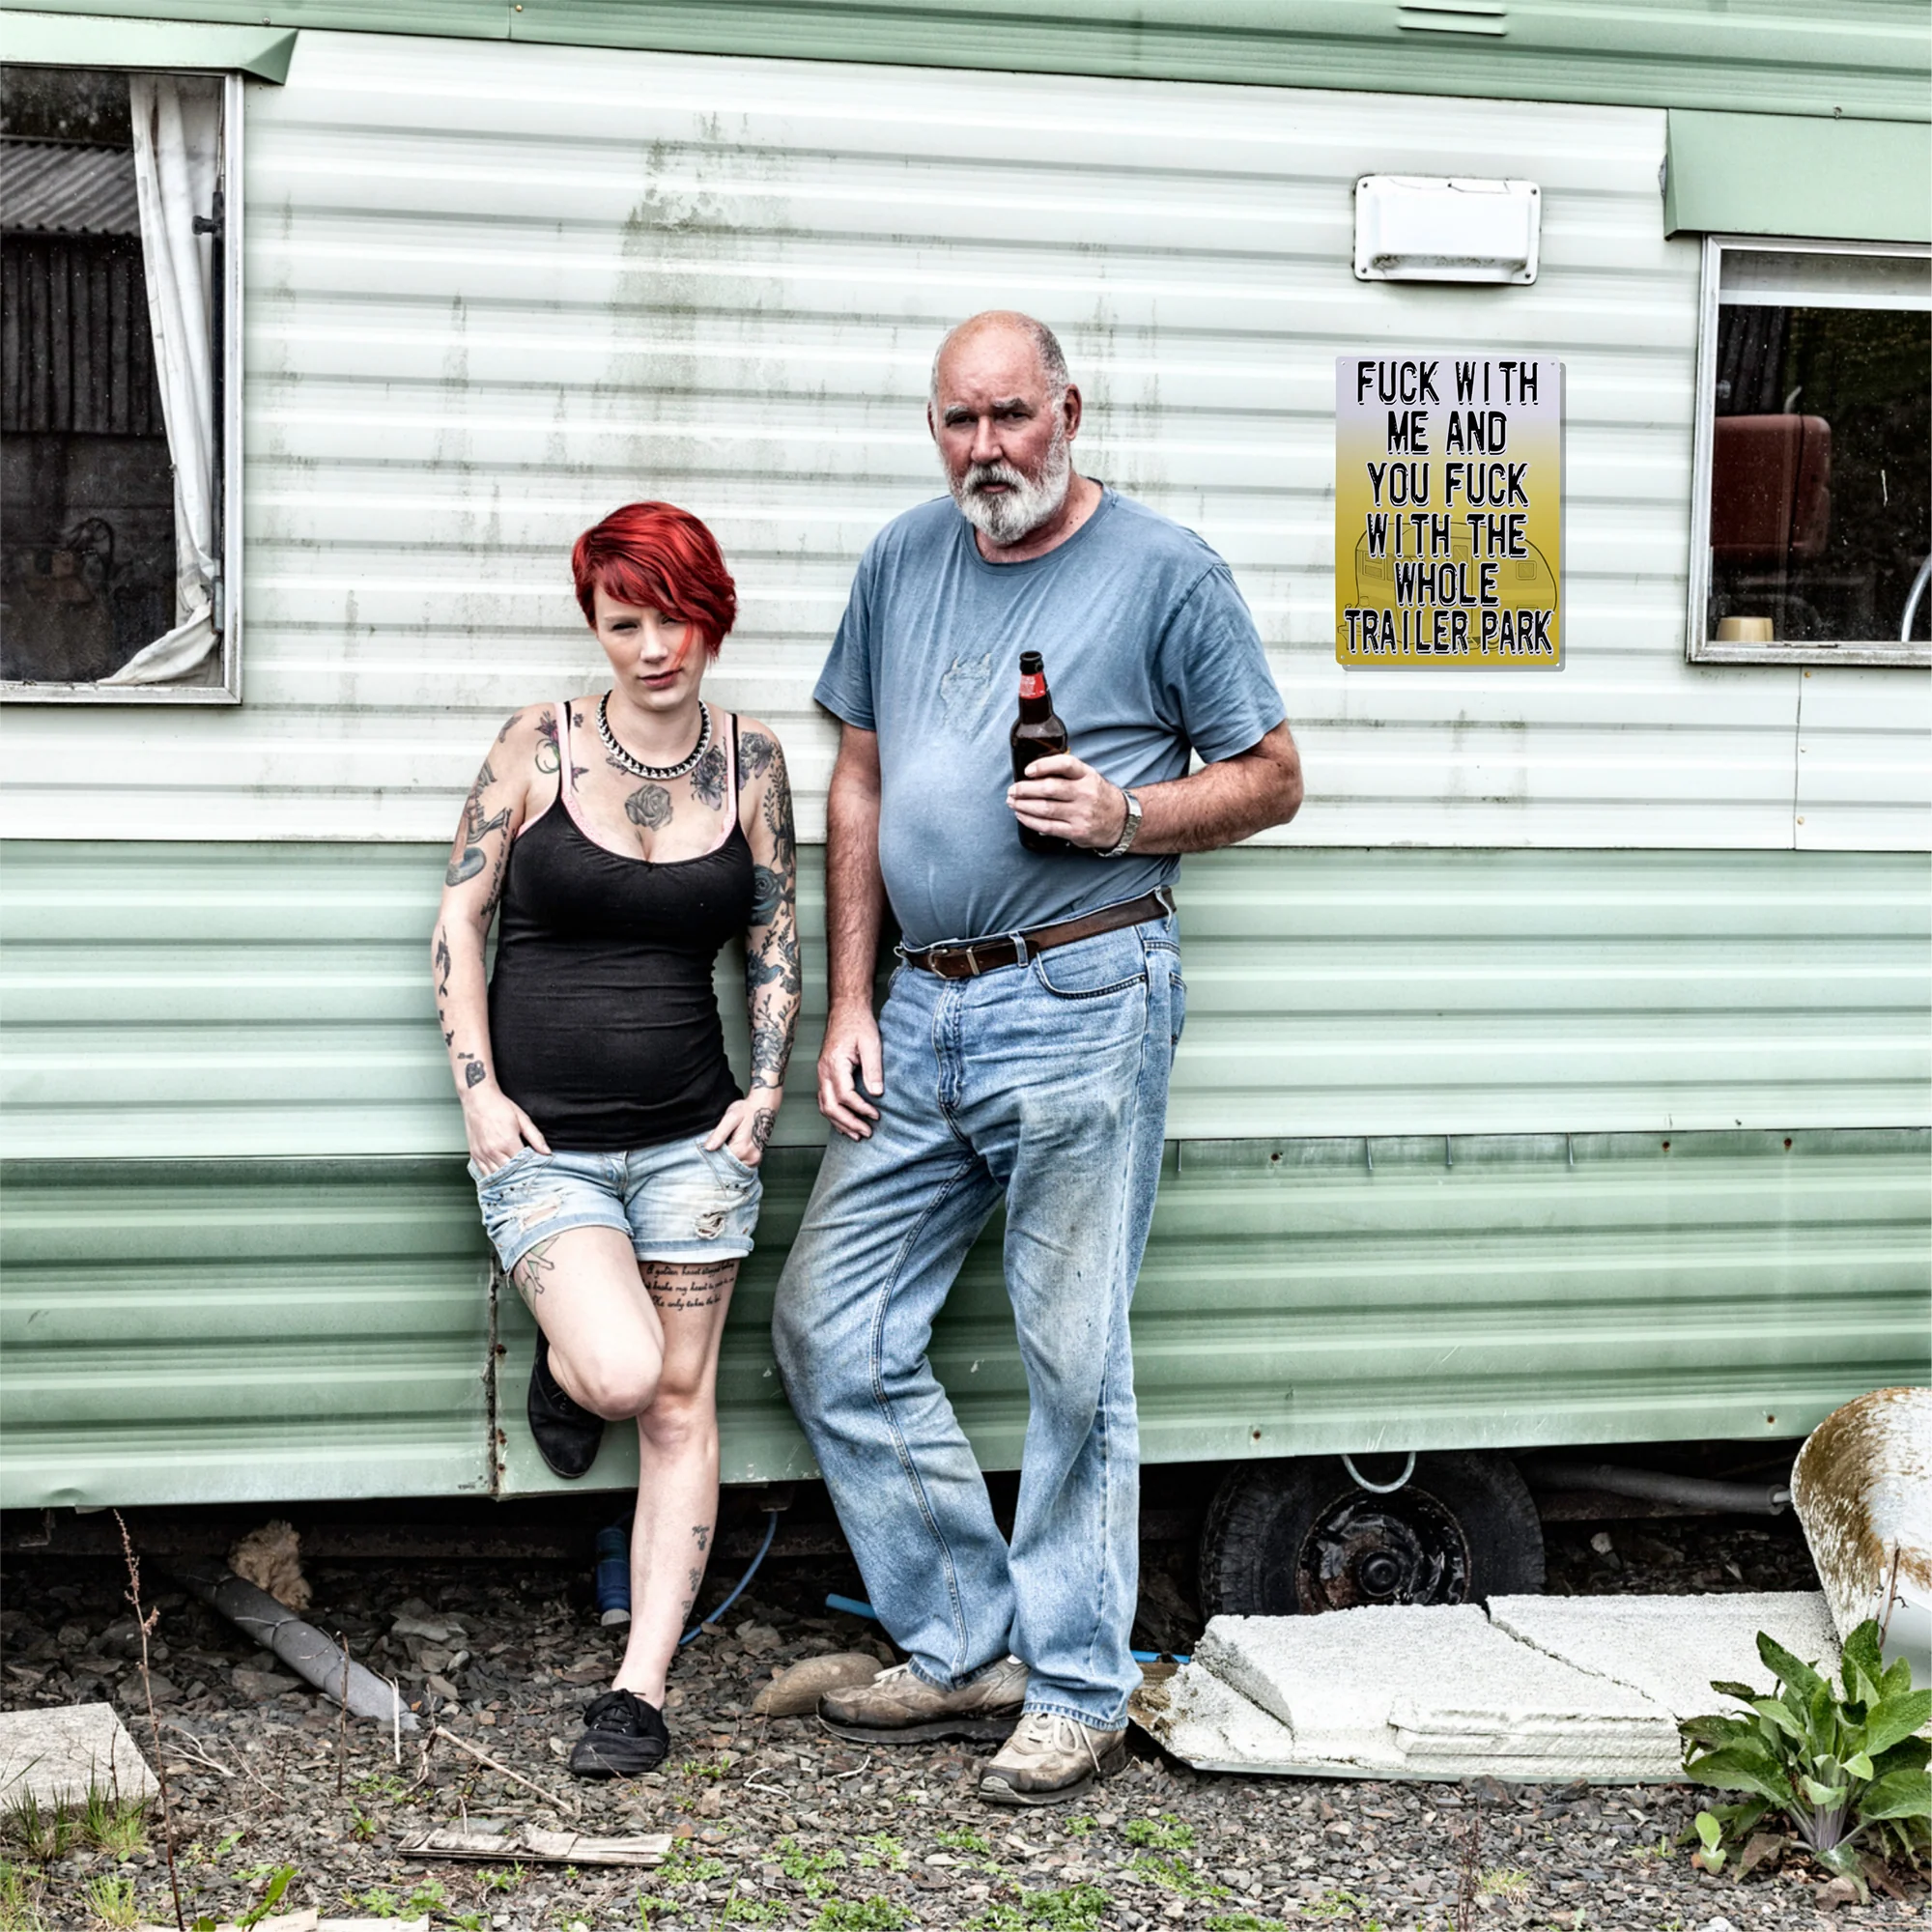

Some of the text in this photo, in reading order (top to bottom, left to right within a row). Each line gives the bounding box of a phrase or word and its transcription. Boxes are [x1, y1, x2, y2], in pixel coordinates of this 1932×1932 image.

[1358, 362, 1537, 405] FUCK WITH
[1388, 412, 1506, 455] ME AND
[1368, 463, 1527, 506] YOU FUCK
[1368, 514, 1526, 557] WITH THE
[1396, 563, 1497, 607] WHOLE
[1346, 611, 1551, 654] TRAILER PARK
[668, 1298, 685, 1311] only
[686, 1297, 704, 1307] takes
[675, 1286, 688, 1296] my
